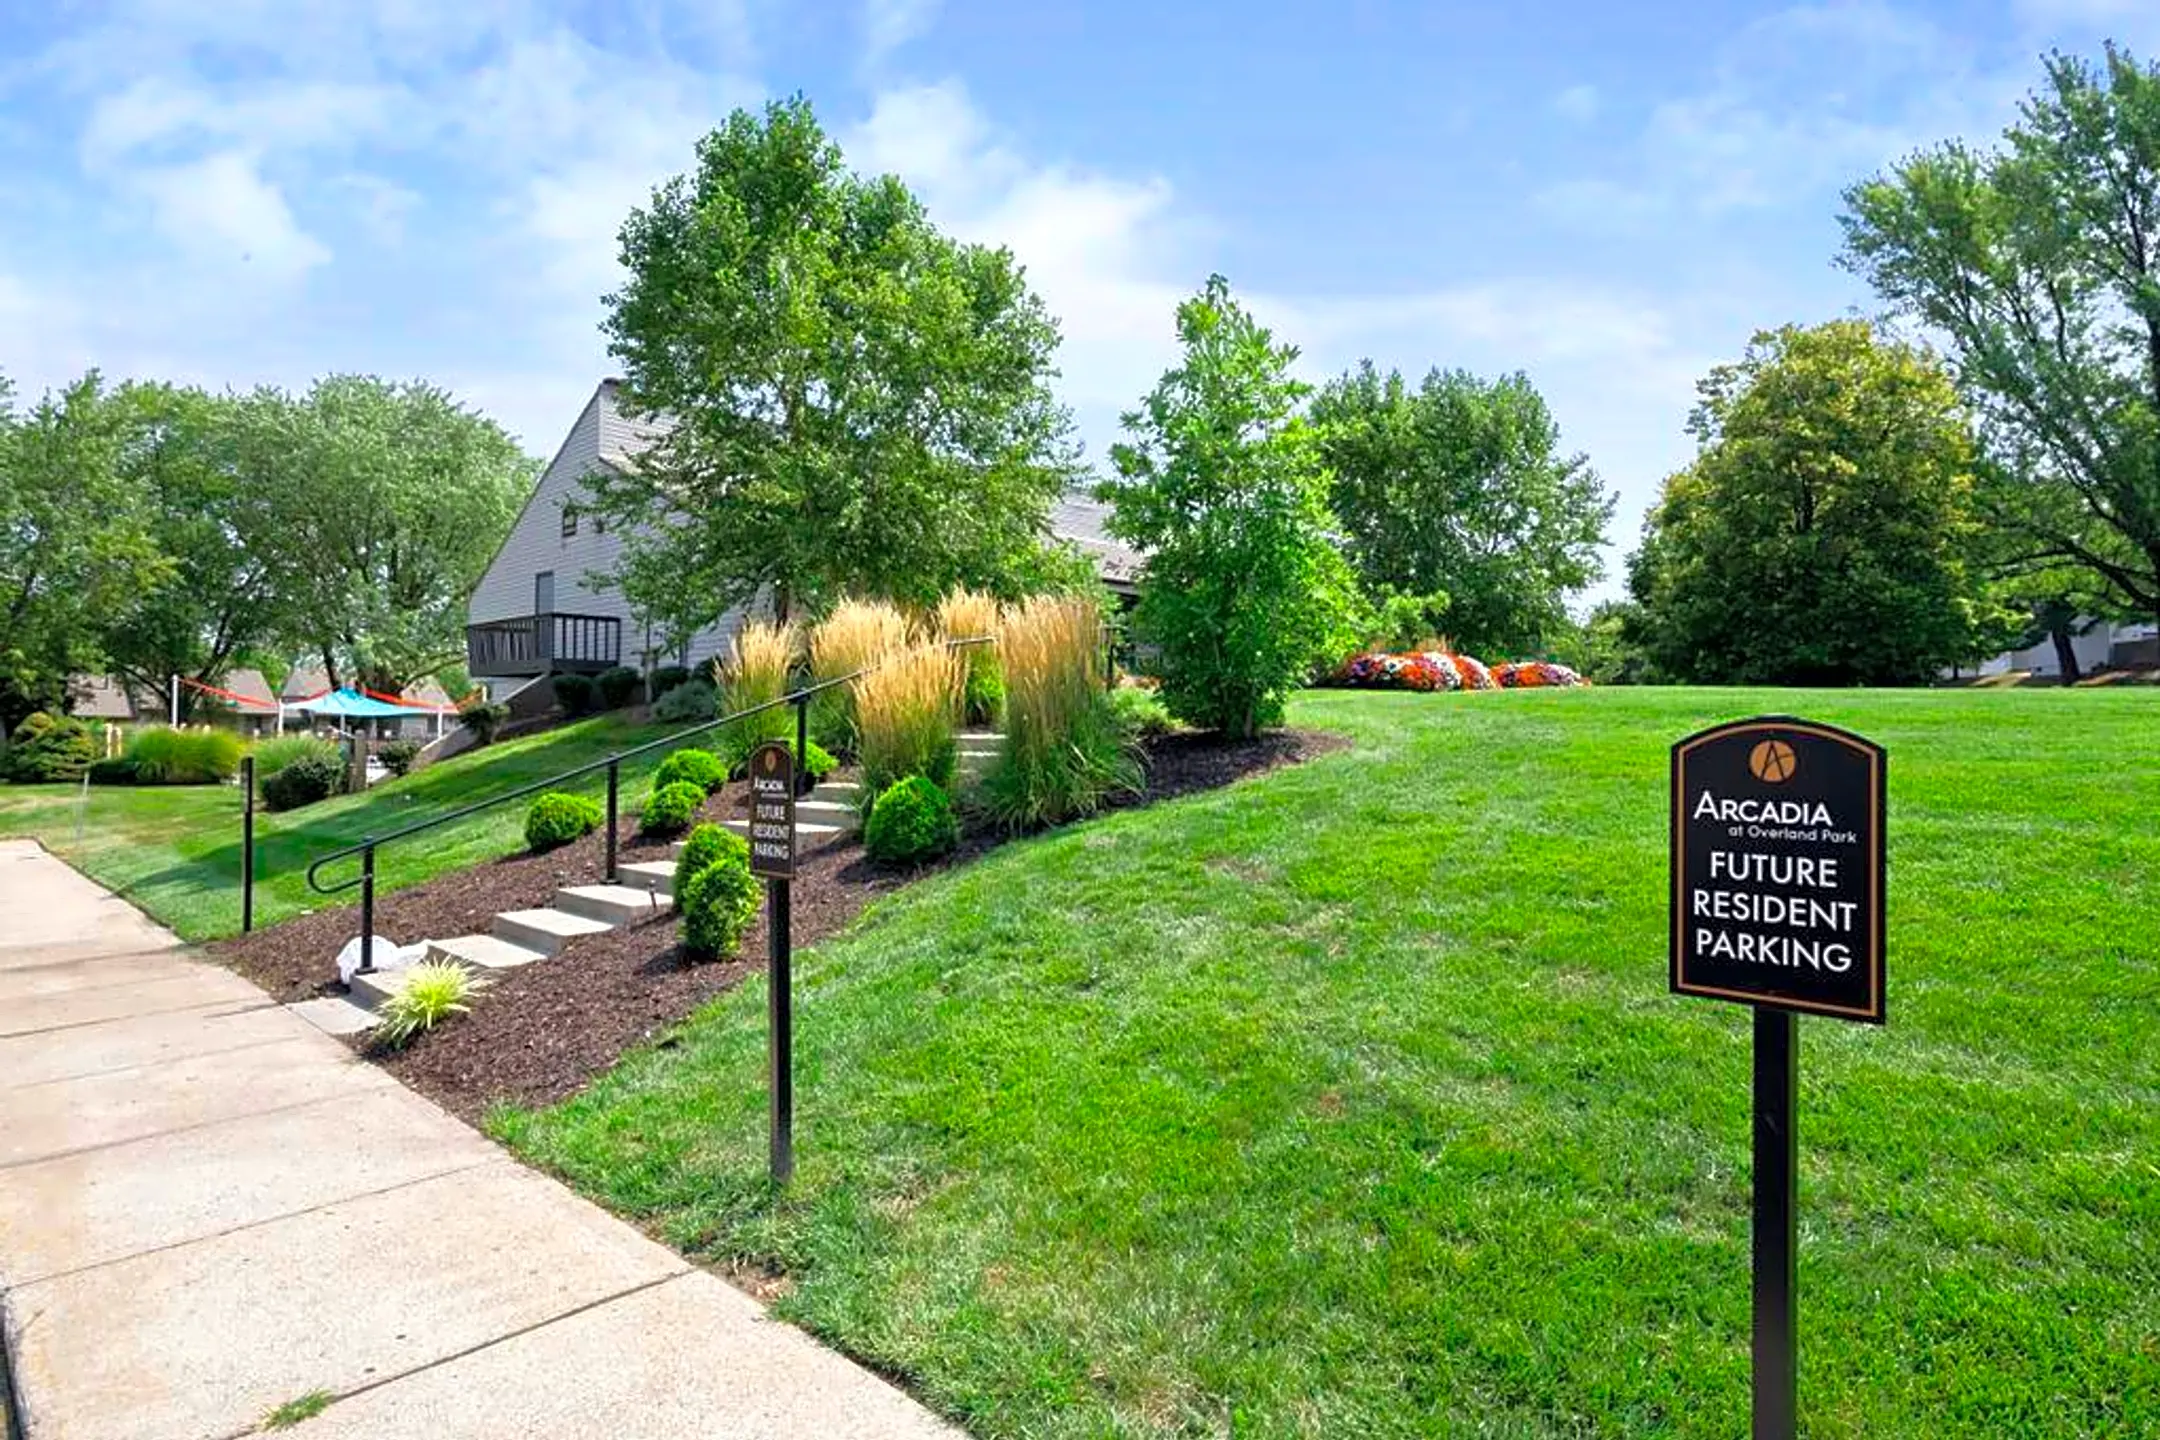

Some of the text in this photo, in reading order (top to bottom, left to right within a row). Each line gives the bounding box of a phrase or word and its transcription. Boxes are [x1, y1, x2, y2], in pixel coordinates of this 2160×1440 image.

[1693, 790, 1833, 826] ARCADIA
[1728, 825, 1857, 844] at Overland Park
[1710, 851, 1838, 888] FUTURE
[1693, 888, 1858, 932] RESIDENT
[1695, 928, 1853, 973] PARKING
